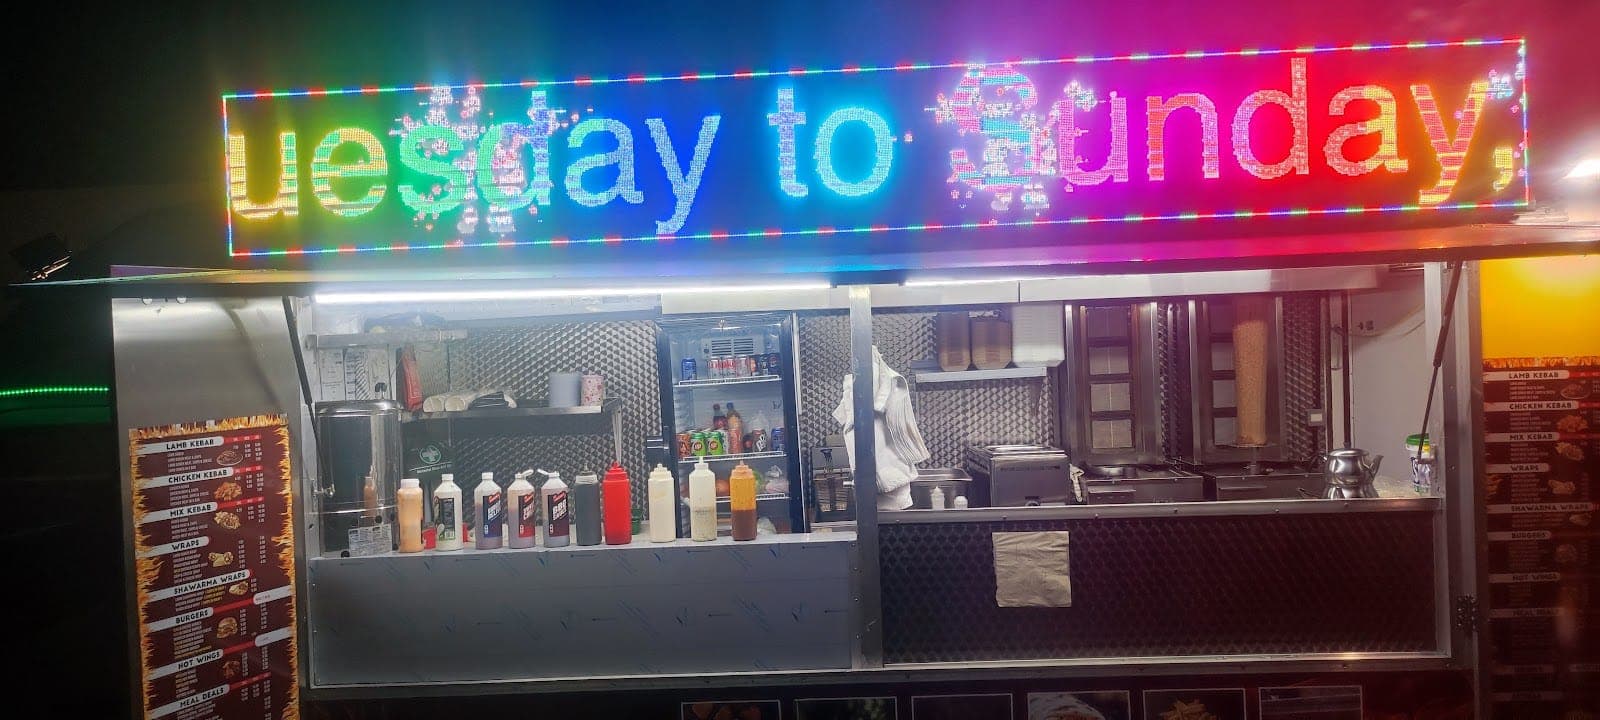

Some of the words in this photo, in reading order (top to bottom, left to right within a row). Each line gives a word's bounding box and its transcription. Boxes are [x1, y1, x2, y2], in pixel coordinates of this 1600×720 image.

[228, 87, 720, 234] uesday
[768, 87, 894, 198] to
[166, 441, 187, 450] LAMB
[190, 438, 214, 448] KEBAB
[168, 473, 201, 484] CHICKEN
[203, 469, 227, 479] KEBAB
[170, 508, 185, 518] MIX
[187, 504, 212, 515] KEBAB
[171, 539, 200, 551] WRAPS
[173, 579, 218, 595] SHAWARMA
[220, 571, 247, 583] WRAPS
[175, 609, 209, 624] BURGERS
[178, 659, 194, 671] HOT
[196, 651, 220, 664] WINGS
[179, 697, 198, 708] MEAL
[201, 688, 224, 701] DEALS
